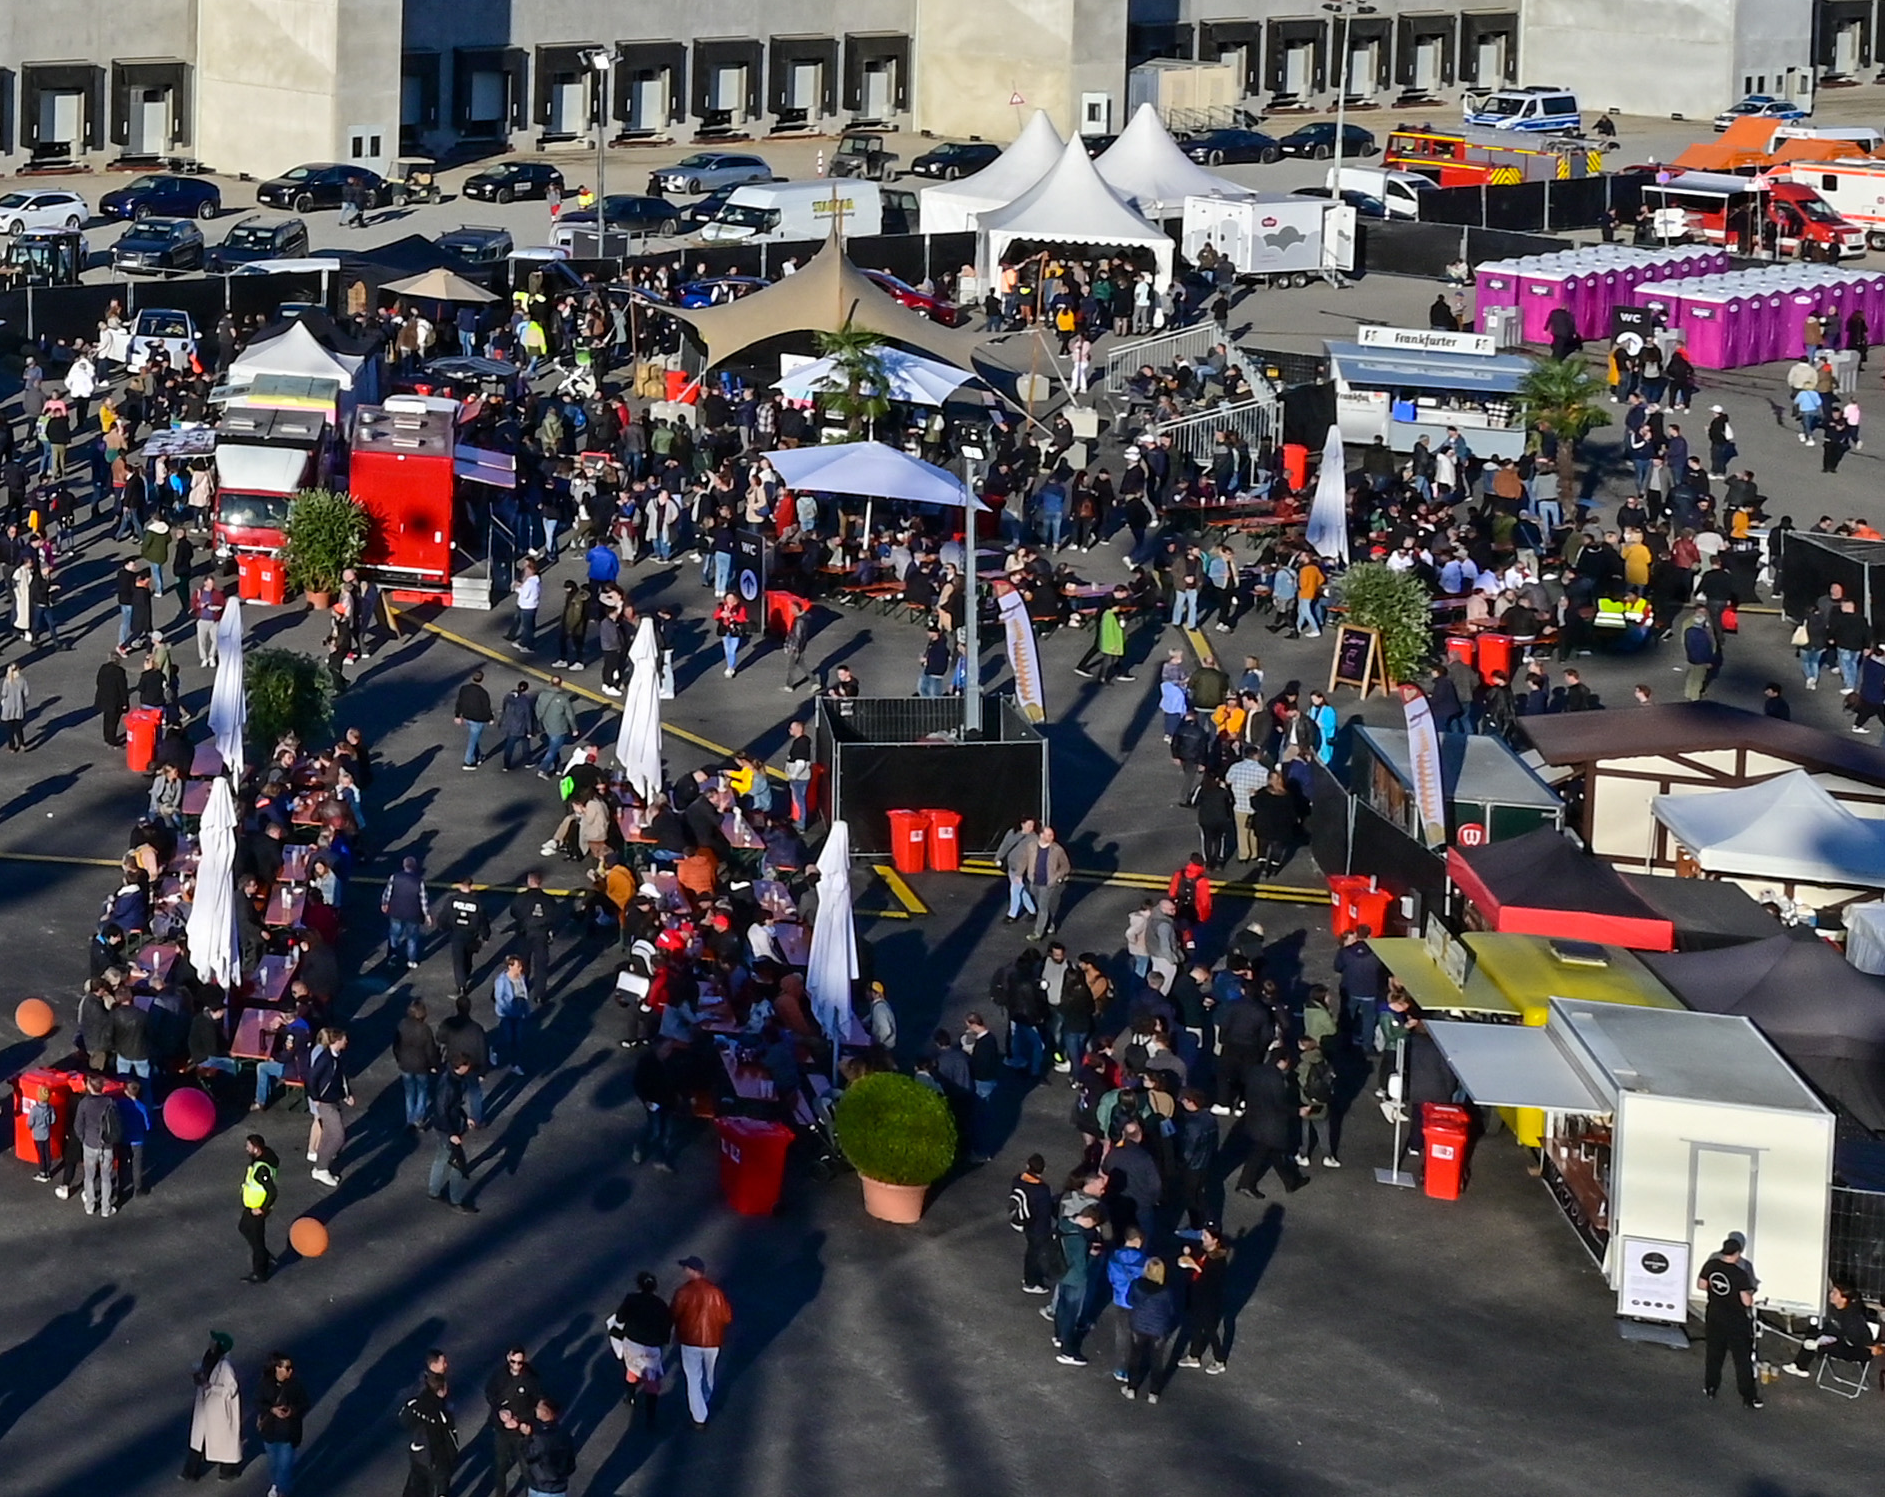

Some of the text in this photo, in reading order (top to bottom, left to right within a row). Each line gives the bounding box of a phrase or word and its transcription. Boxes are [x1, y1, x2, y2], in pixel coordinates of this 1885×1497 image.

[1620, 312, 1642, 324] WC
[1394, 332, 1457, 348] Frankfurter
[741, 541, 757, 557] WC
